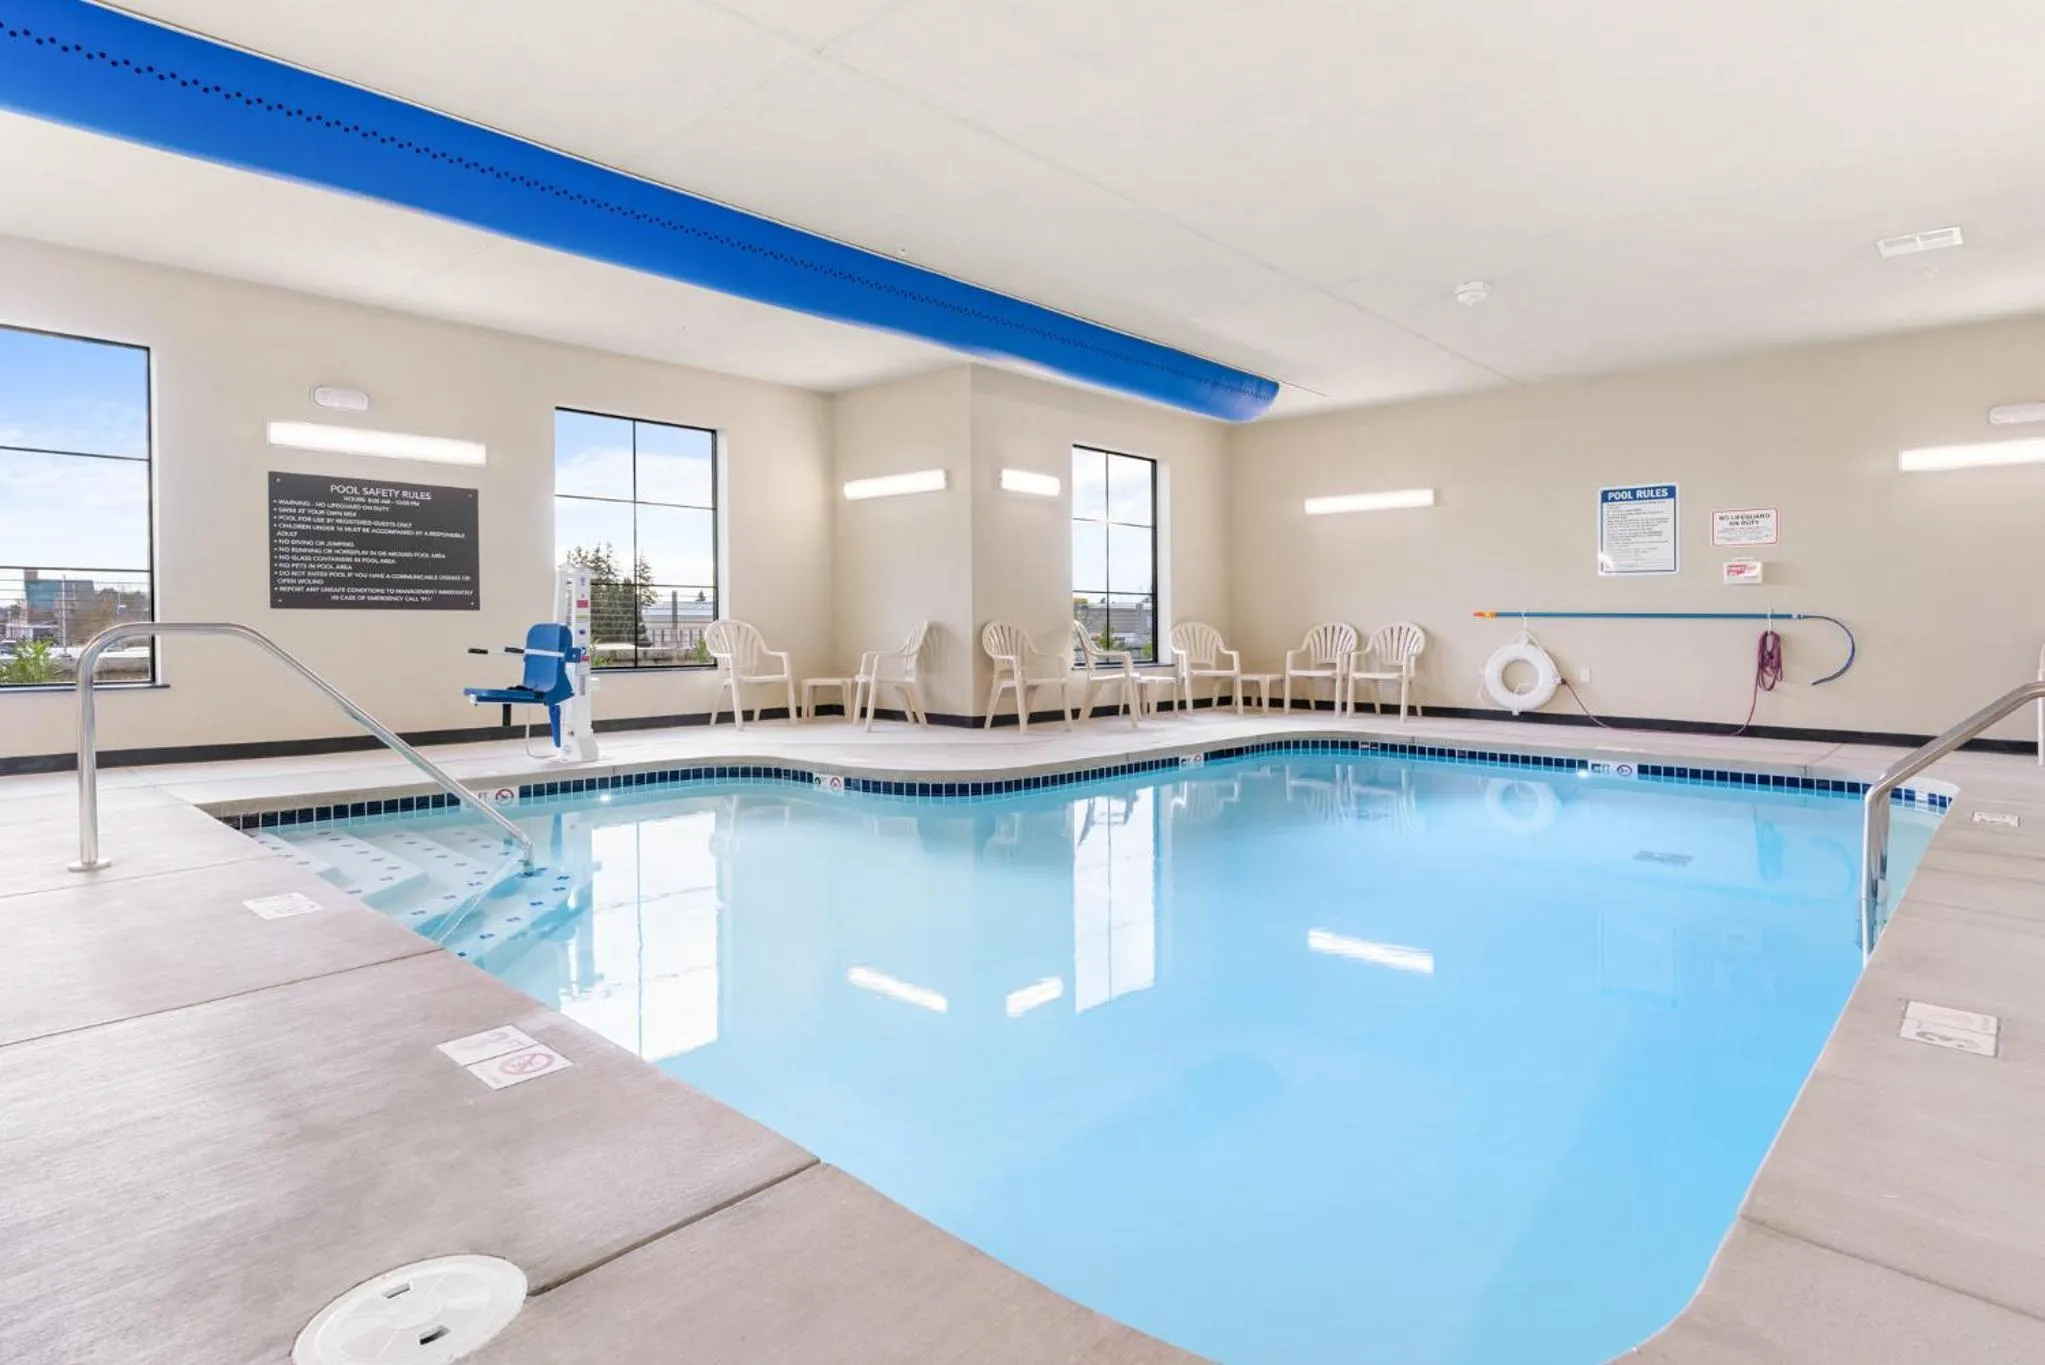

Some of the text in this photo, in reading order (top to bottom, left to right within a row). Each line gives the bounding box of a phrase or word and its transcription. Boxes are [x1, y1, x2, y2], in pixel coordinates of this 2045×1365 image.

[330, 484, 431, 499] POOL SAFETY RULES
[1608, 488, 1668, 500] POOL RULES
[327, 502, 361, 510] LIFEGUARD
